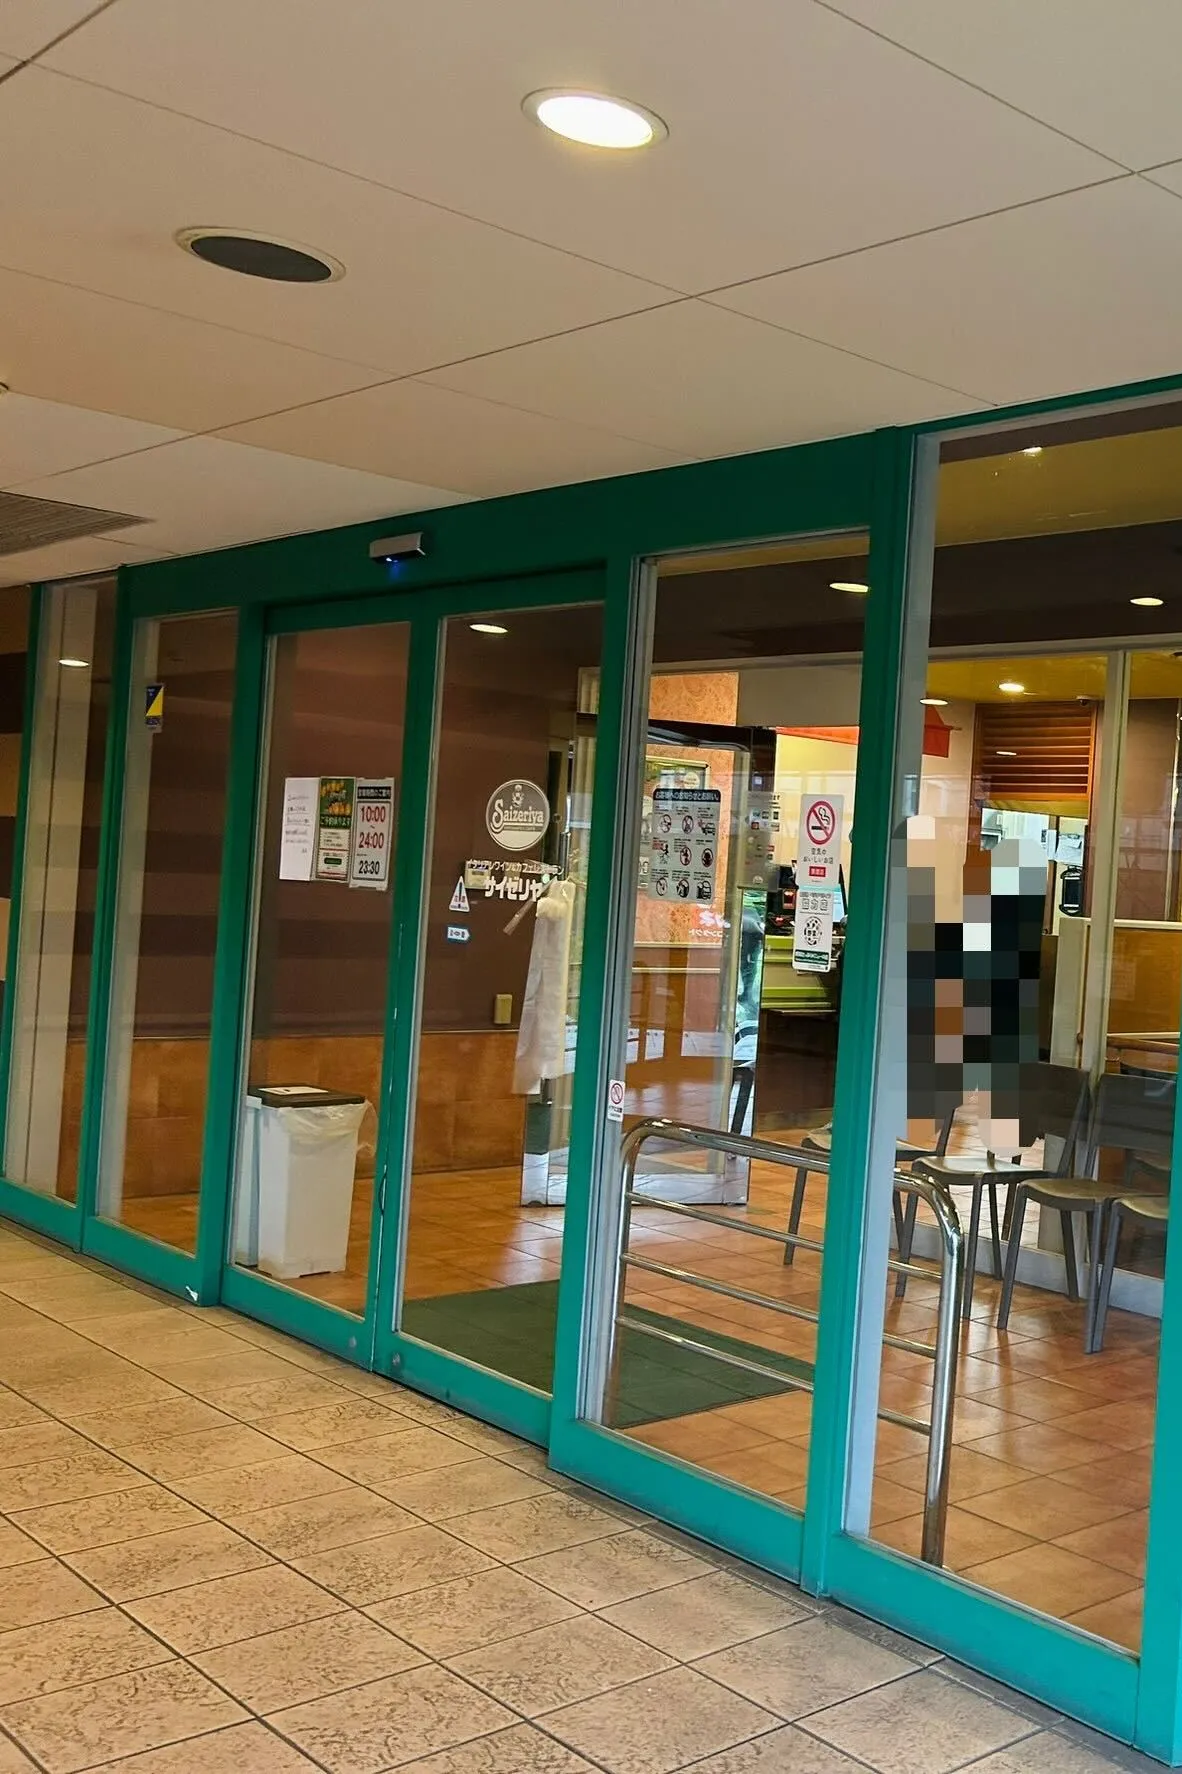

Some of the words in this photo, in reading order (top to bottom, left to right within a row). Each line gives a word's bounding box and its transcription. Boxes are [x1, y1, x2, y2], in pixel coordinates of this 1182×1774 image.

[361, 805, 386, 822] 10:00
[491, 798, 545, 829] Saizeriya
[358, 832, 384, 849] 24:00
[358, 860, 380, 875] 23:30
[484, 875, 543, 903] サイゼリヤ
